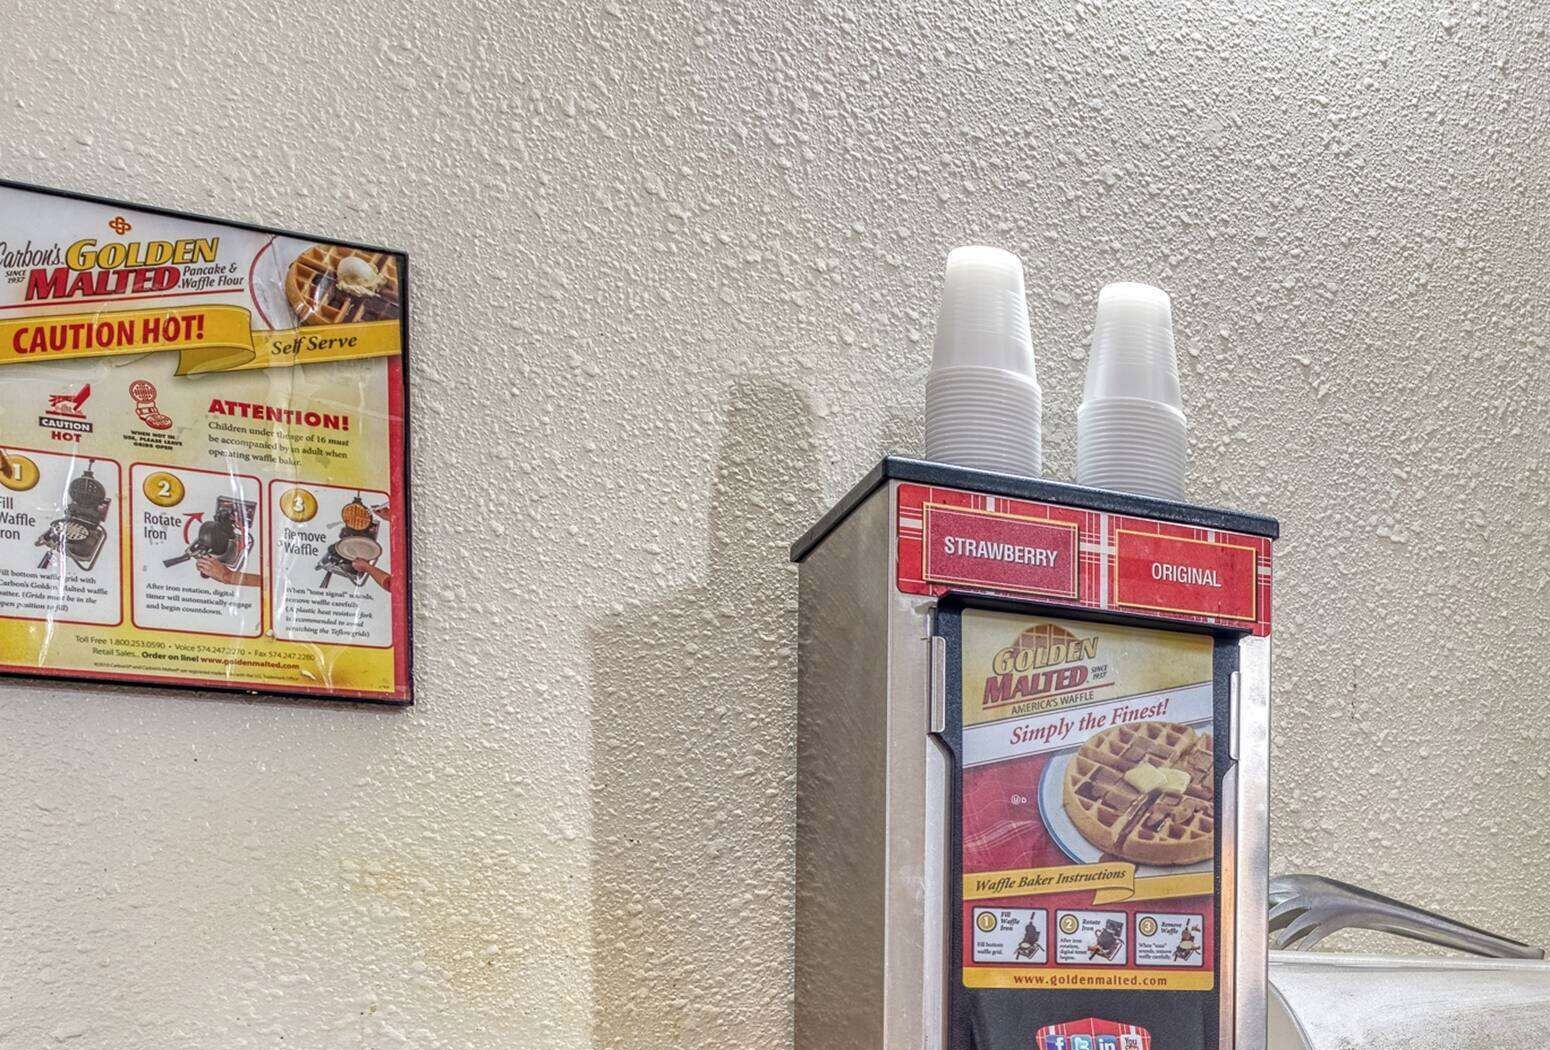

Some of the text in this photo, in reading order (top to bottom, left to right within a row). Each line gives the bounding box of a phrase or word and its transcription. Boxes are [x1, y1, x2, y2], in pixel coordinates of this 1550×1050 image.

[65, 237, 219, 271] GOLDEN
[183, 262, 237, 276] Pancake &
[25, 266, 181, 301] MALTED
[181, 275, 244, 290] Waffle Flour
[13, 314, 204, 354] CAUTION HOT!
[271, 336, 357, 355] Self Serve
[208, 399, 349, 431] ATTENTION!
[41, 418, 90, 431] CAUTION
[51, 431, 82, 442] HOT
[208, 421, 247, 433] Children
[249, 428, 274, 437] under
[306, 434, 314, 442] of
[328, 438, 349, 447] must
[208, 434, 219, 443] be
[221, 438, 277, 450] accompanied
[302, 445, 324, 456] adult
[325, 449, 348, 459] when
[251, 454, 277, 463] waffle
[12, 463, 22, 481] 1
[158, 480, 171, 497] 2
[293, 497, 305, 513] 3
[144, 511, 182, 527] Rotate
[0, 529, 20, 541] ron
[144, 526, 167, 540] Iron
[285, 541, 319, 556] Waffle
[943, 535, 1058, 569] STRAWBERRY
[1151, 562, 1222, 588] ORIGINAL
[161, 603, 180, 612] begin
[76, 635, 89, 643] Toll
[91, 636, 107, 644] Free
[175, 643, 195, 651] Voice
[254, 649, 267, 657] Fax
[93, 647, 115, 656] Retail
[141, 651, 167, 661] Order
[181, 654, 199, 663] line!
[992, 636, 1099, 676] GOLDEN
[982, 665, 1089, 705] MALTED
[1011, 691, 1095, 715] AMERICA'S WAFFLE
[1009, 698, 1170, 745] Simply the Finest!
[976, 868, 1127, 893] Waffle Baker Instructions
[1065, 917, 1073, 929] 2
[1144, 922, 1152, 931] 3
[1013, 974, 1168, 986] www.goldenmalted.com
